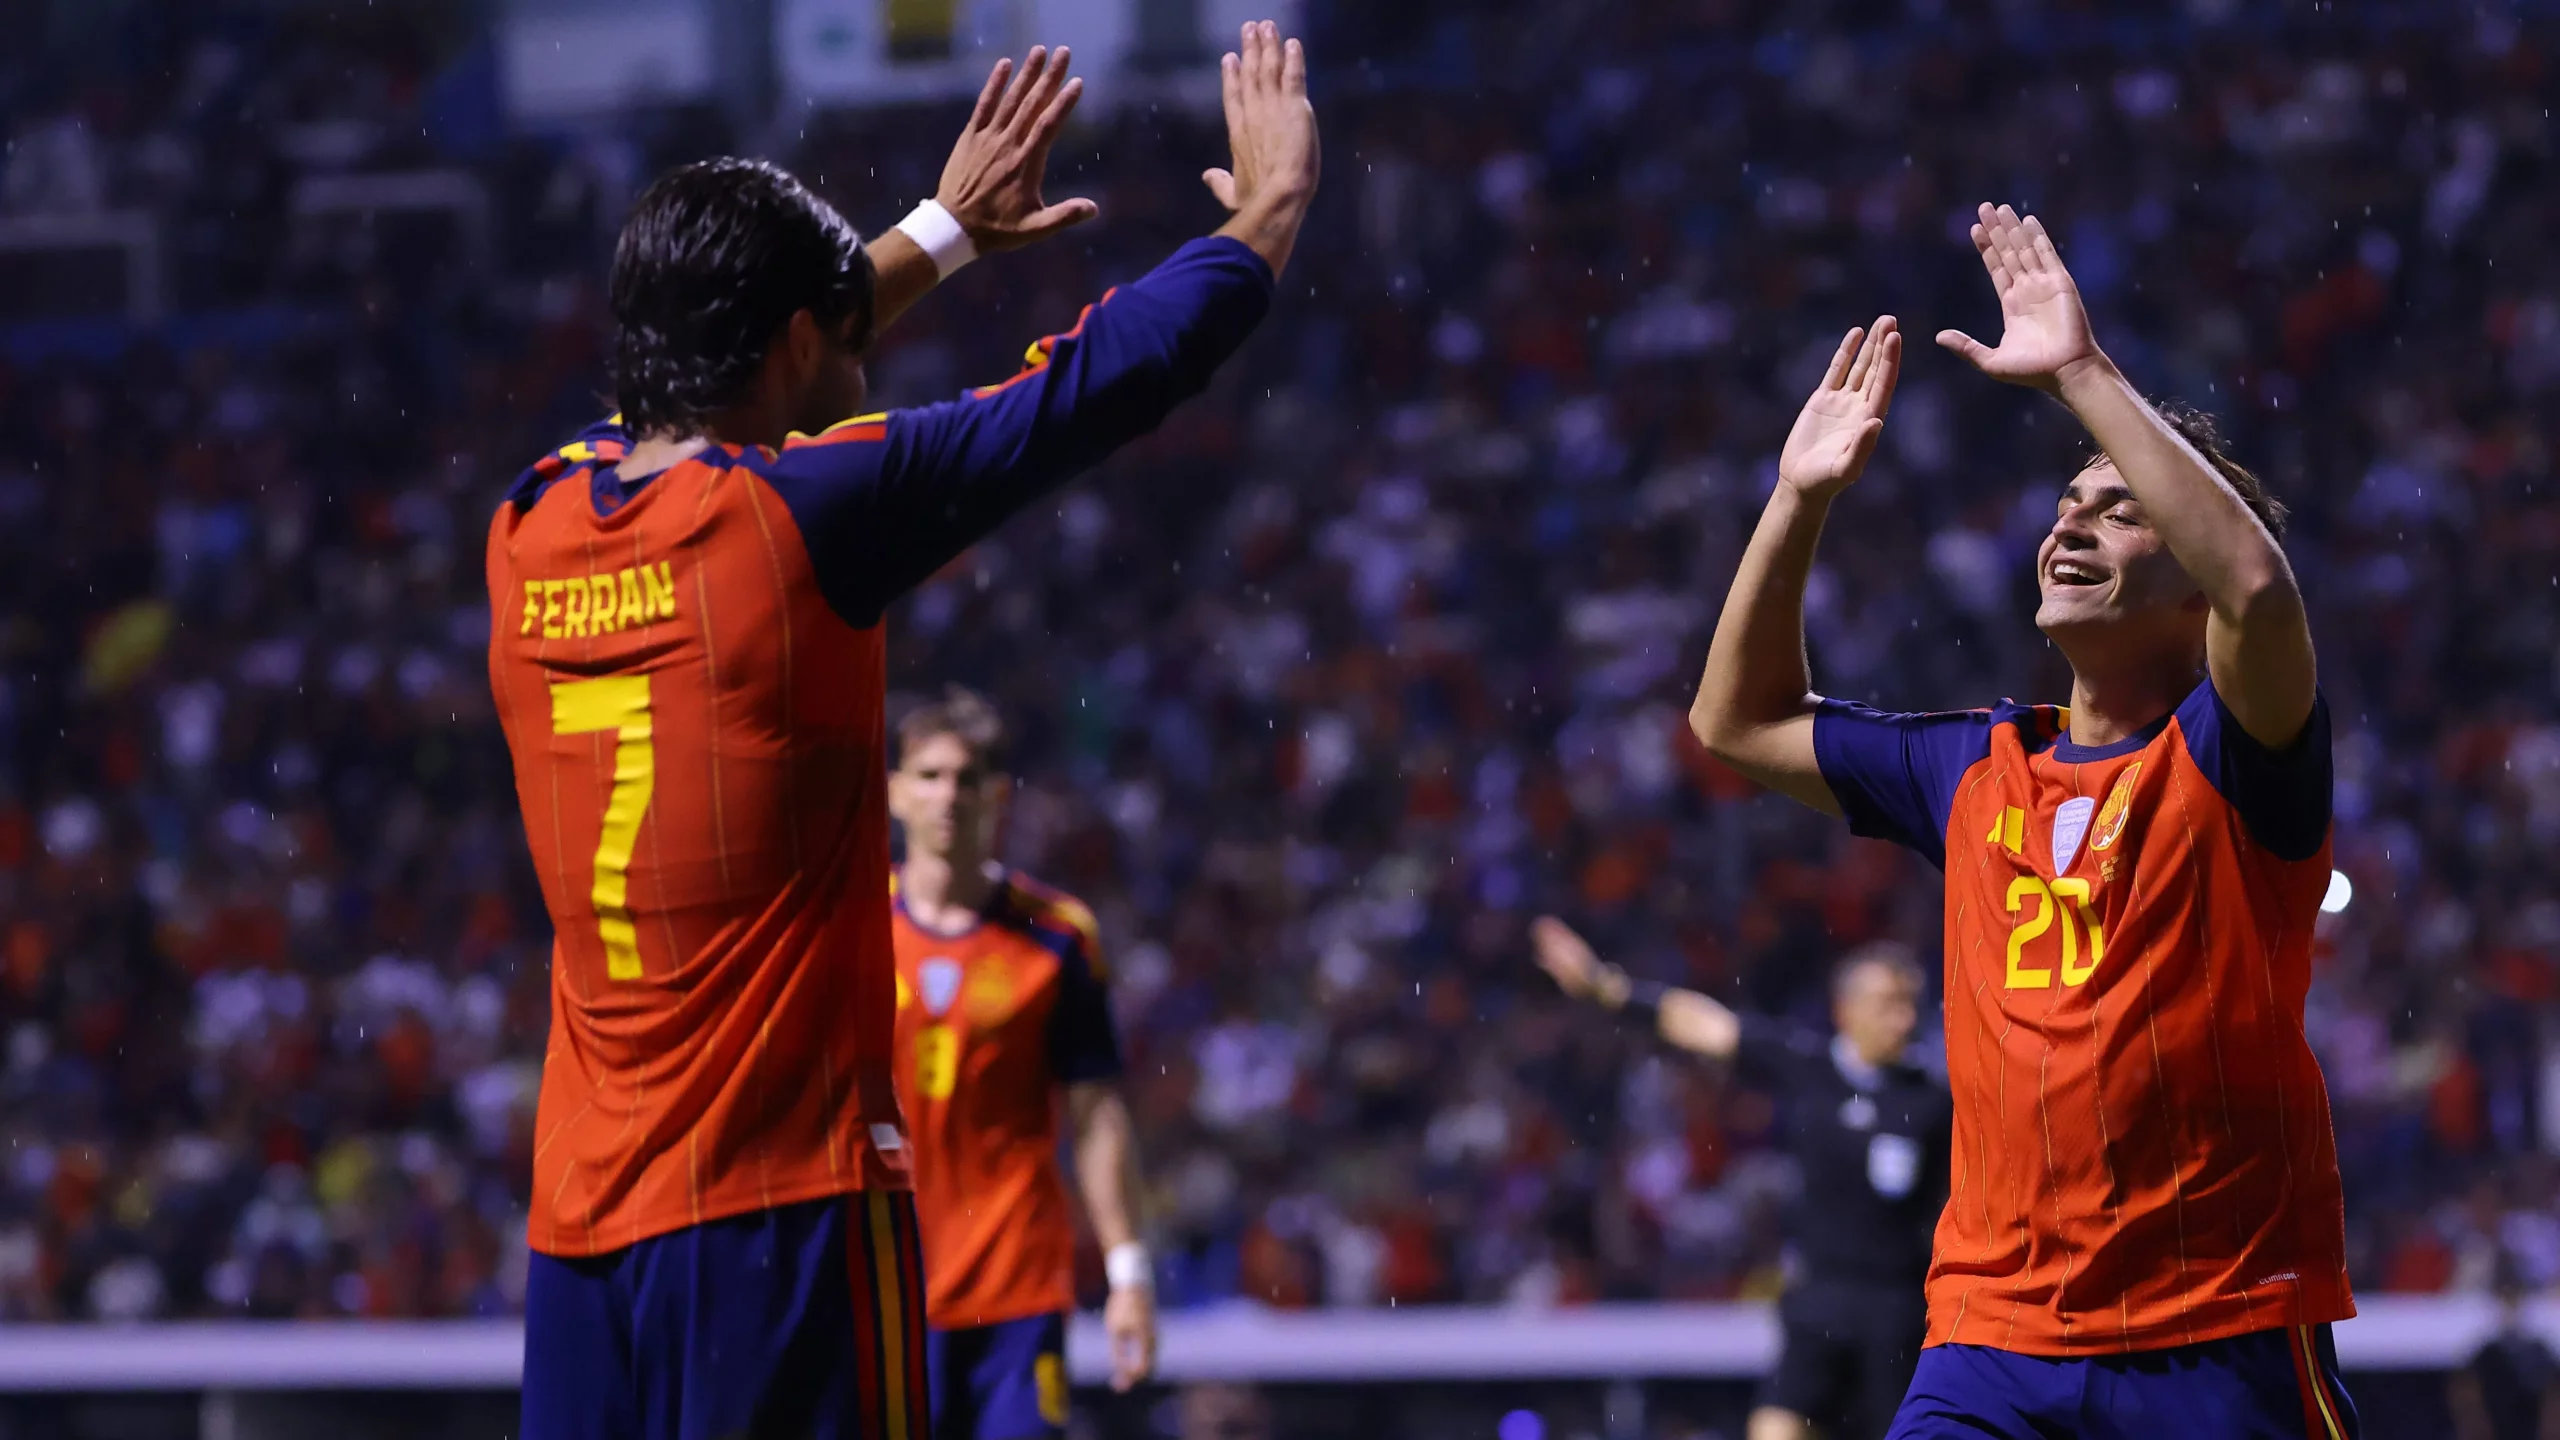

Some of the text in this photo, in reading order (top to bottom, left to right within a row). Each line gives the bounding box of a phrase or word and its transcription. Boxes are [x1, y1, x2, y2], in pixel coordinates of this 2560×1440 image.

[520, 561, 675, 640] FERRAN
[549, 674, 654, 981] 7
[2004, 875, 2104, 989] 20
